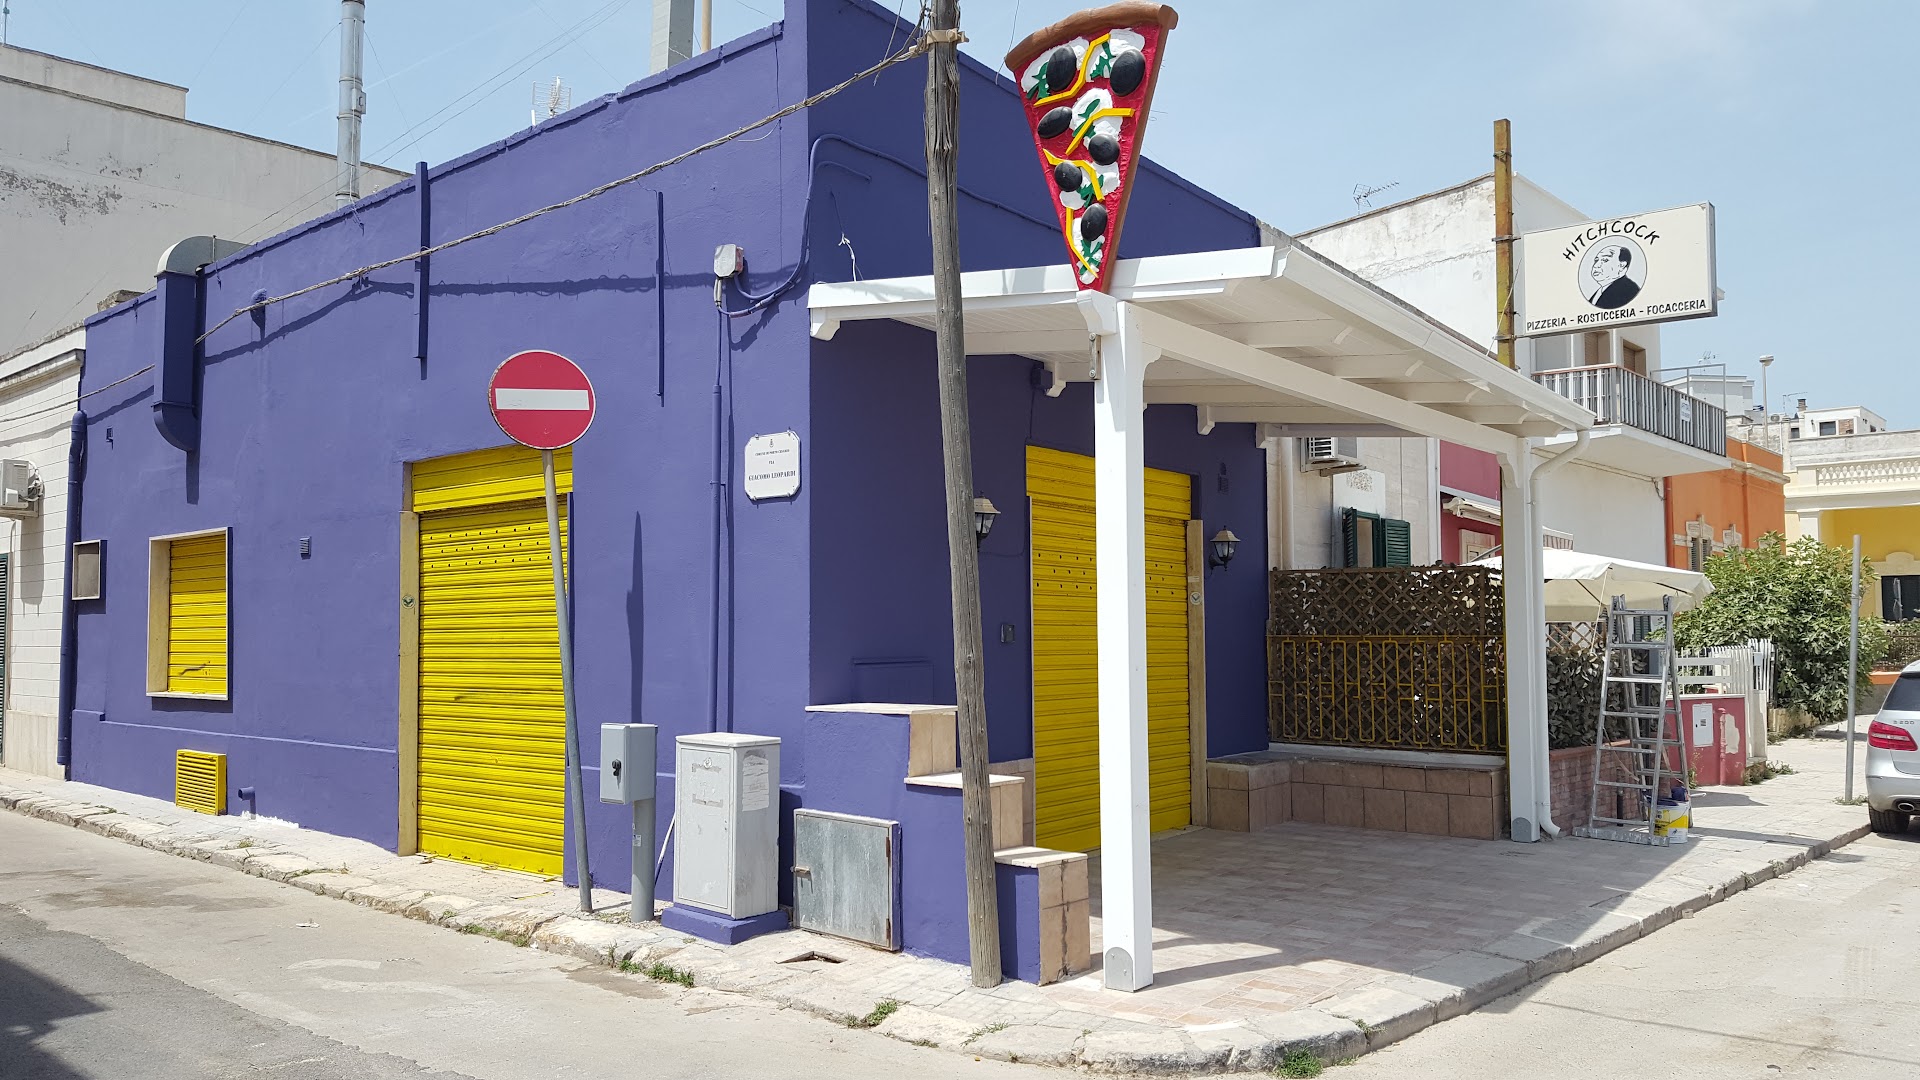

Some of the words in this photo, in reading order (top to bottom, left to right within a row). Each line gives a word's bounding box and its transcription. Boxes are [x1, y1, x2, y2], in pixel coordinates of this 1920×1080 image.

[1562, 220, 1660, 261] HITCHCOCK
[1526, 317, 1567, 331] PIZZERIA
[1577, 308, 1636, 325] ROSTICCERIA
[1646, 299, 1707, 315] FOCACCERIA
[748, 473, 770, 481] GIACOMO
[771, 470, 796, 478] LEOPARDI
